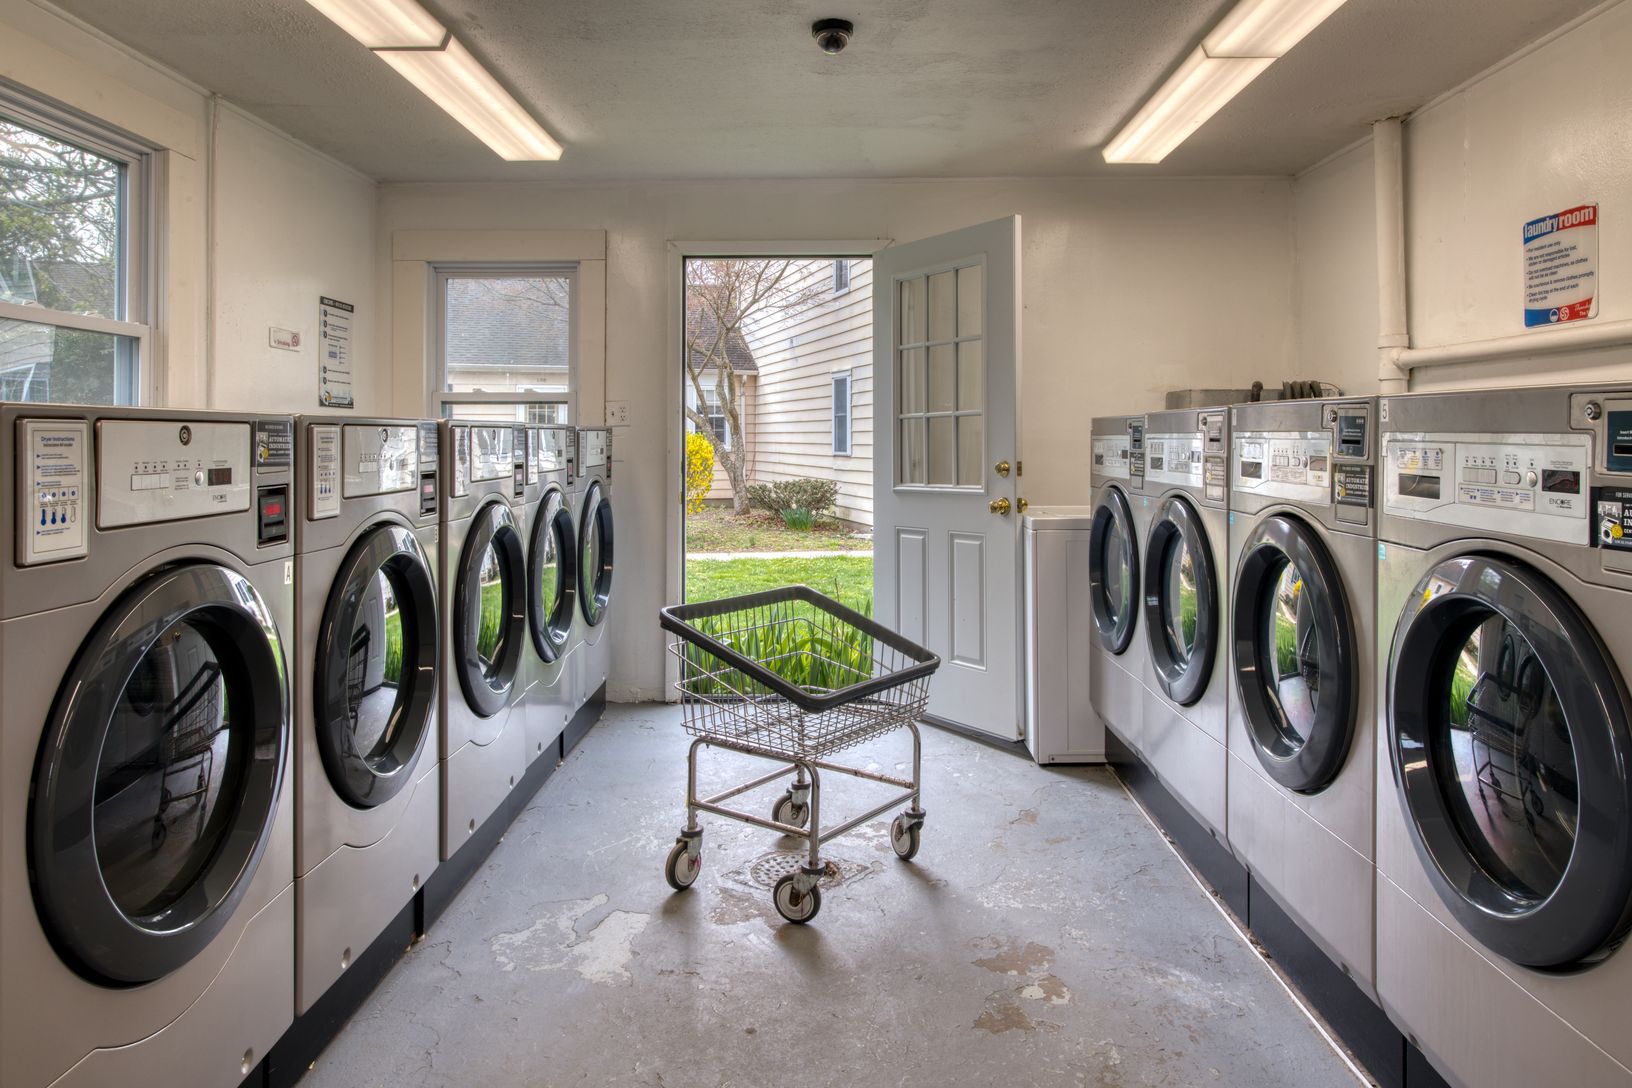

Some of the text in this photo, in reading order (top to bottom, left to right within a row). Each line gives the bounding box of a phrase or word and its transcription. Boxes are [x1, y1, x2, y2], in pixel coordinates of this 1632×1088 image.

[1524, 207, 1594, 238] laundry room
[1382, 403, 1388, 420] 5
